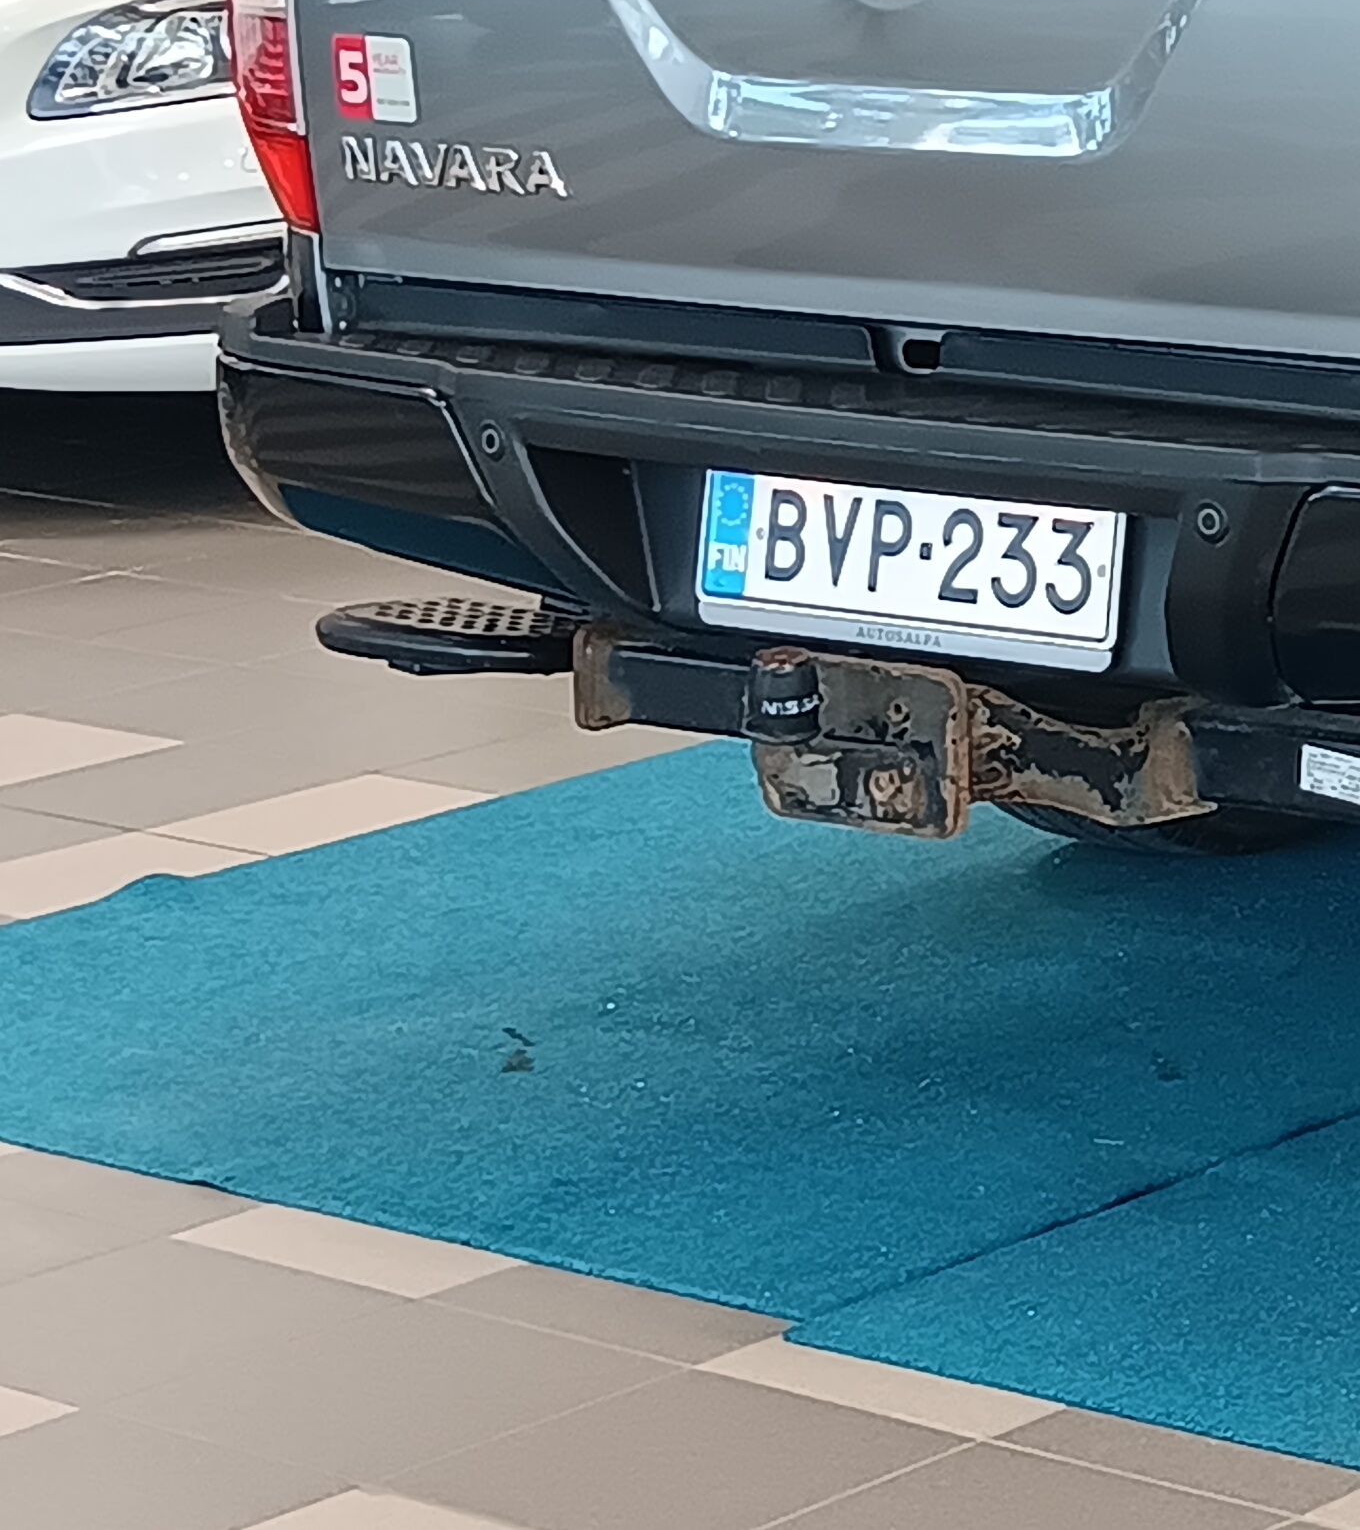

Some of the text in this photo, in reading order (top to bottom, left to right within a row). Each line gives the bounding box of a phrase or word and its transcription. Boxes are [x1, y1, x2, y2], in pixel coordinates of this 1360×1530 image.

[339, 49, 368, 104] 5
[340, 135, 569, 198] NAVARA
[708, 542, 748, 573] FIN
[763, 488, 1095, 616] BVP-233
[856, 625, 942, 649] AUTOSALPA
